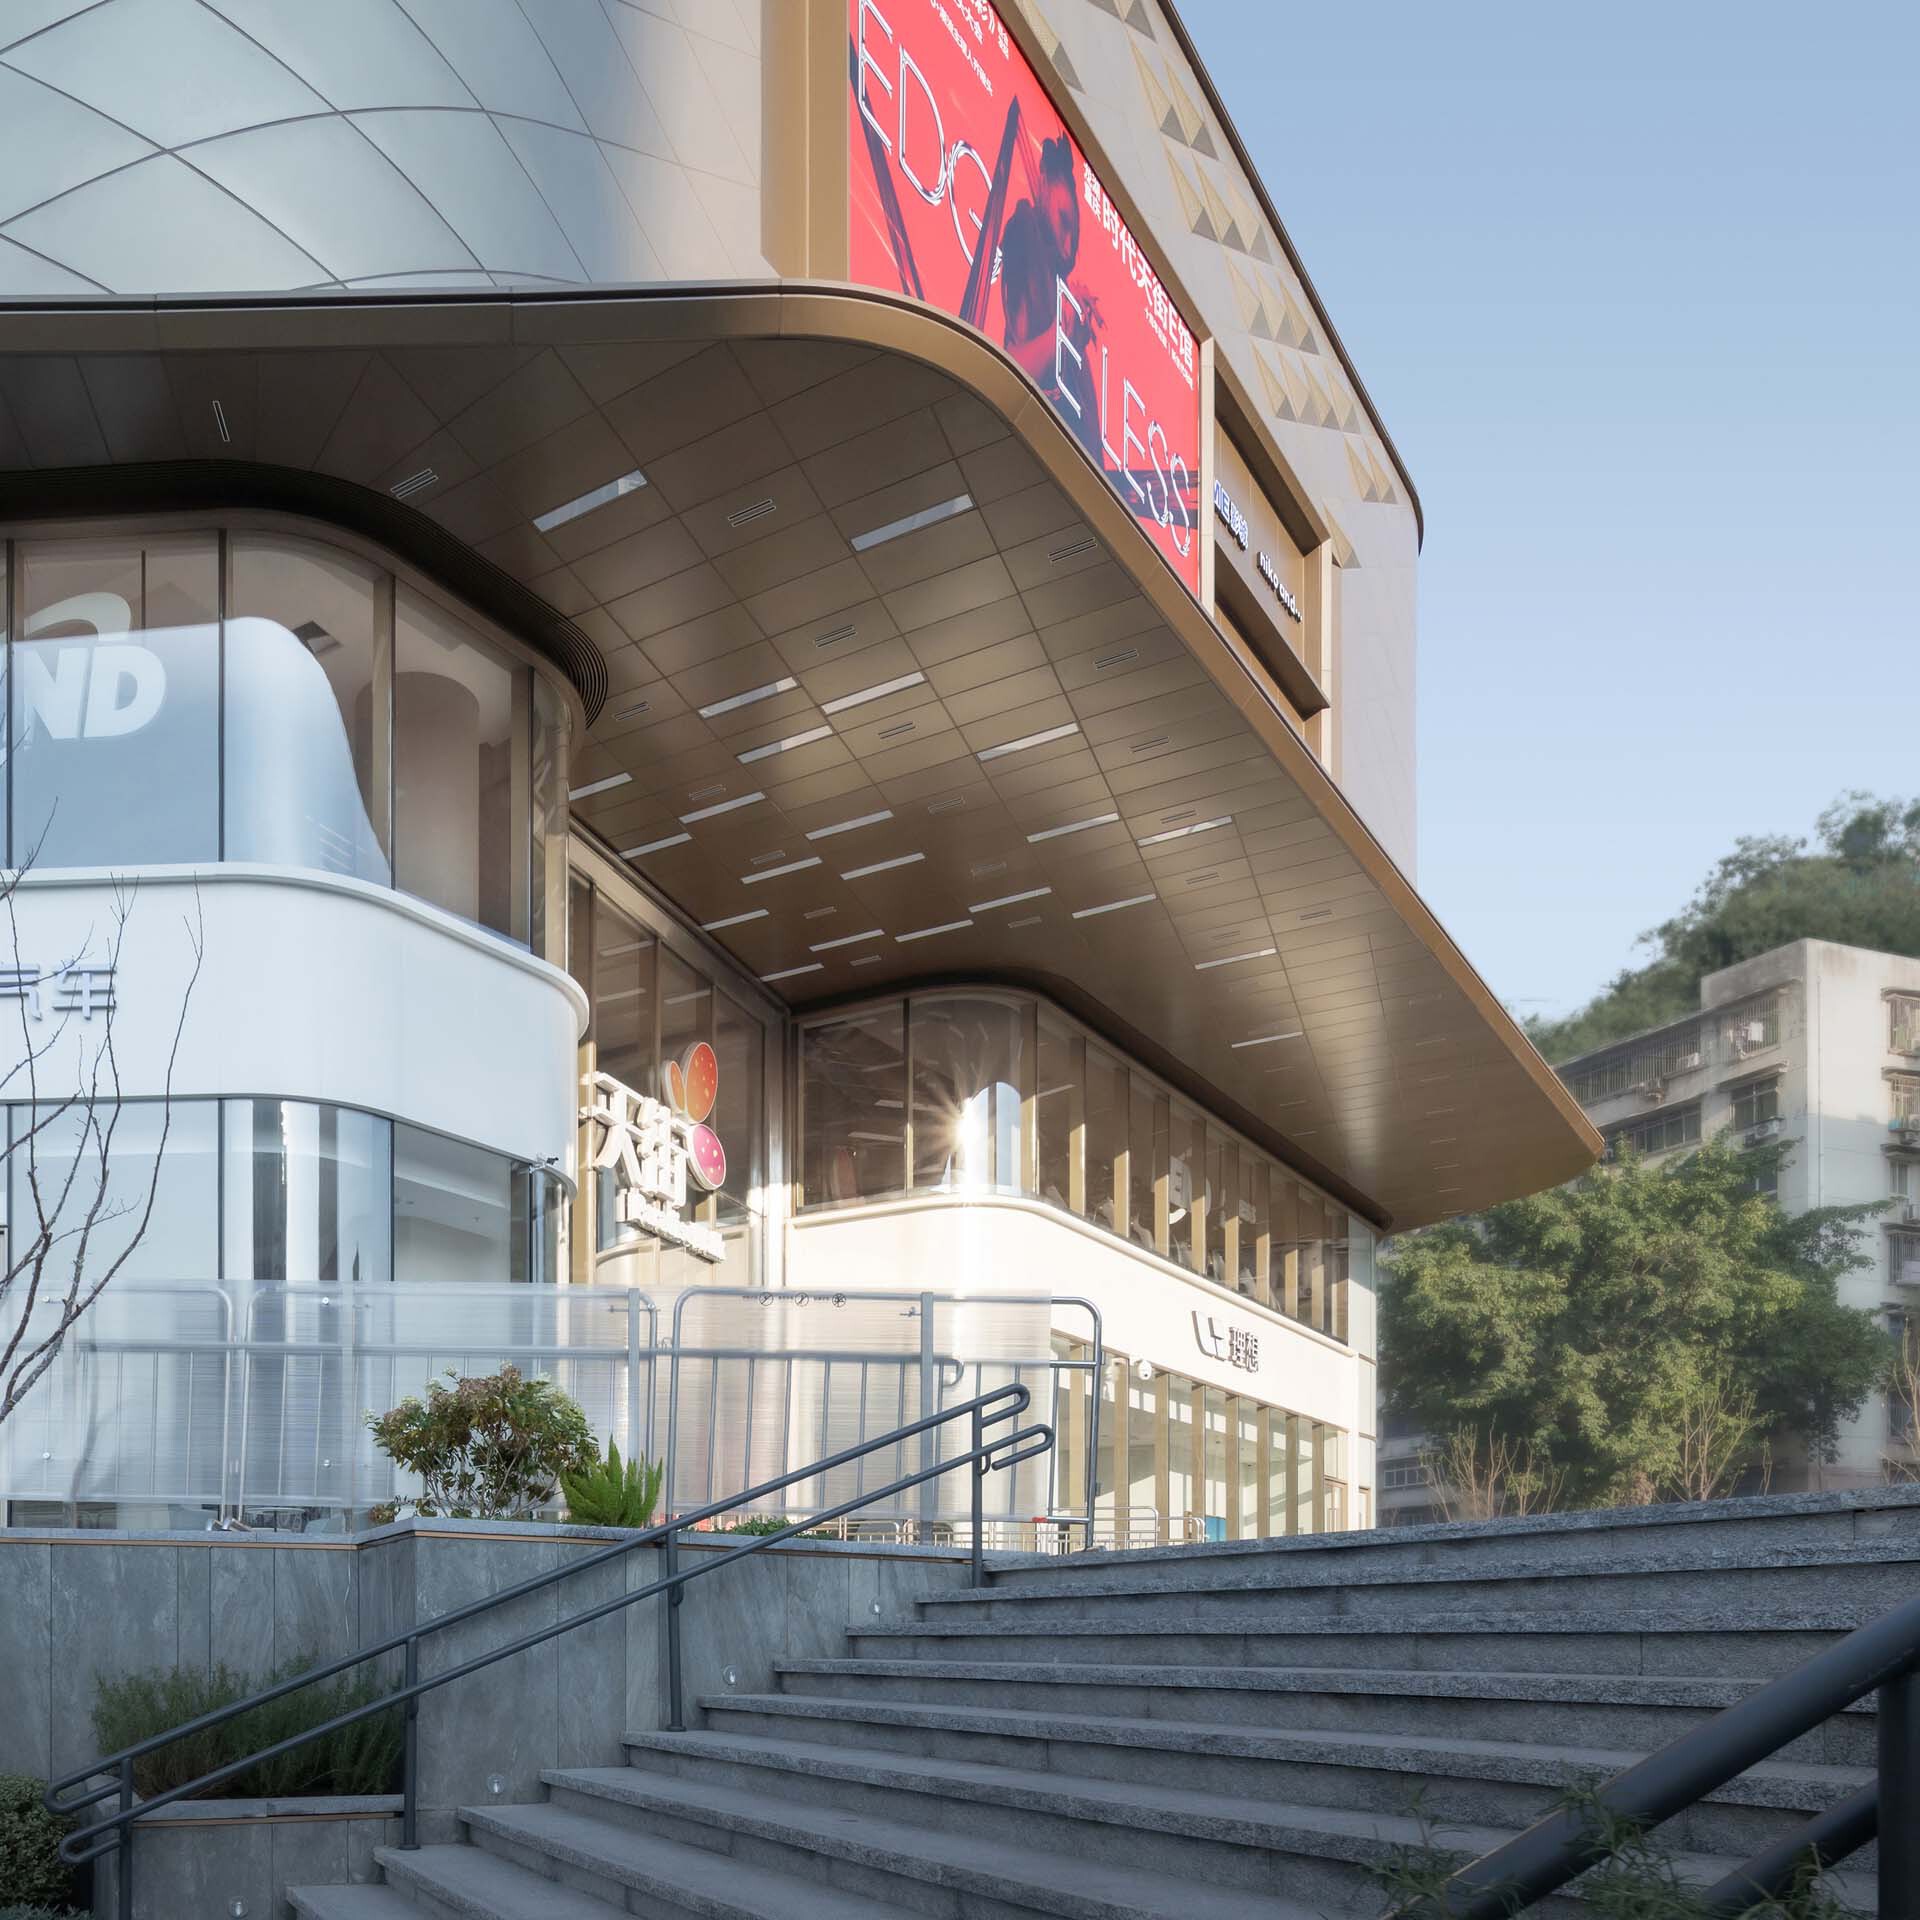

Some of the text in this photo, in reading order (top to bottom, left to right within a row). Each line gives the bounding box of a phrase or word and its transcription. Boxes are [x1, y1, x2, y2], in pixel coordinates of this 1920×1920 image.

[1103, 192, 1194, 373] 时代天街E馆
